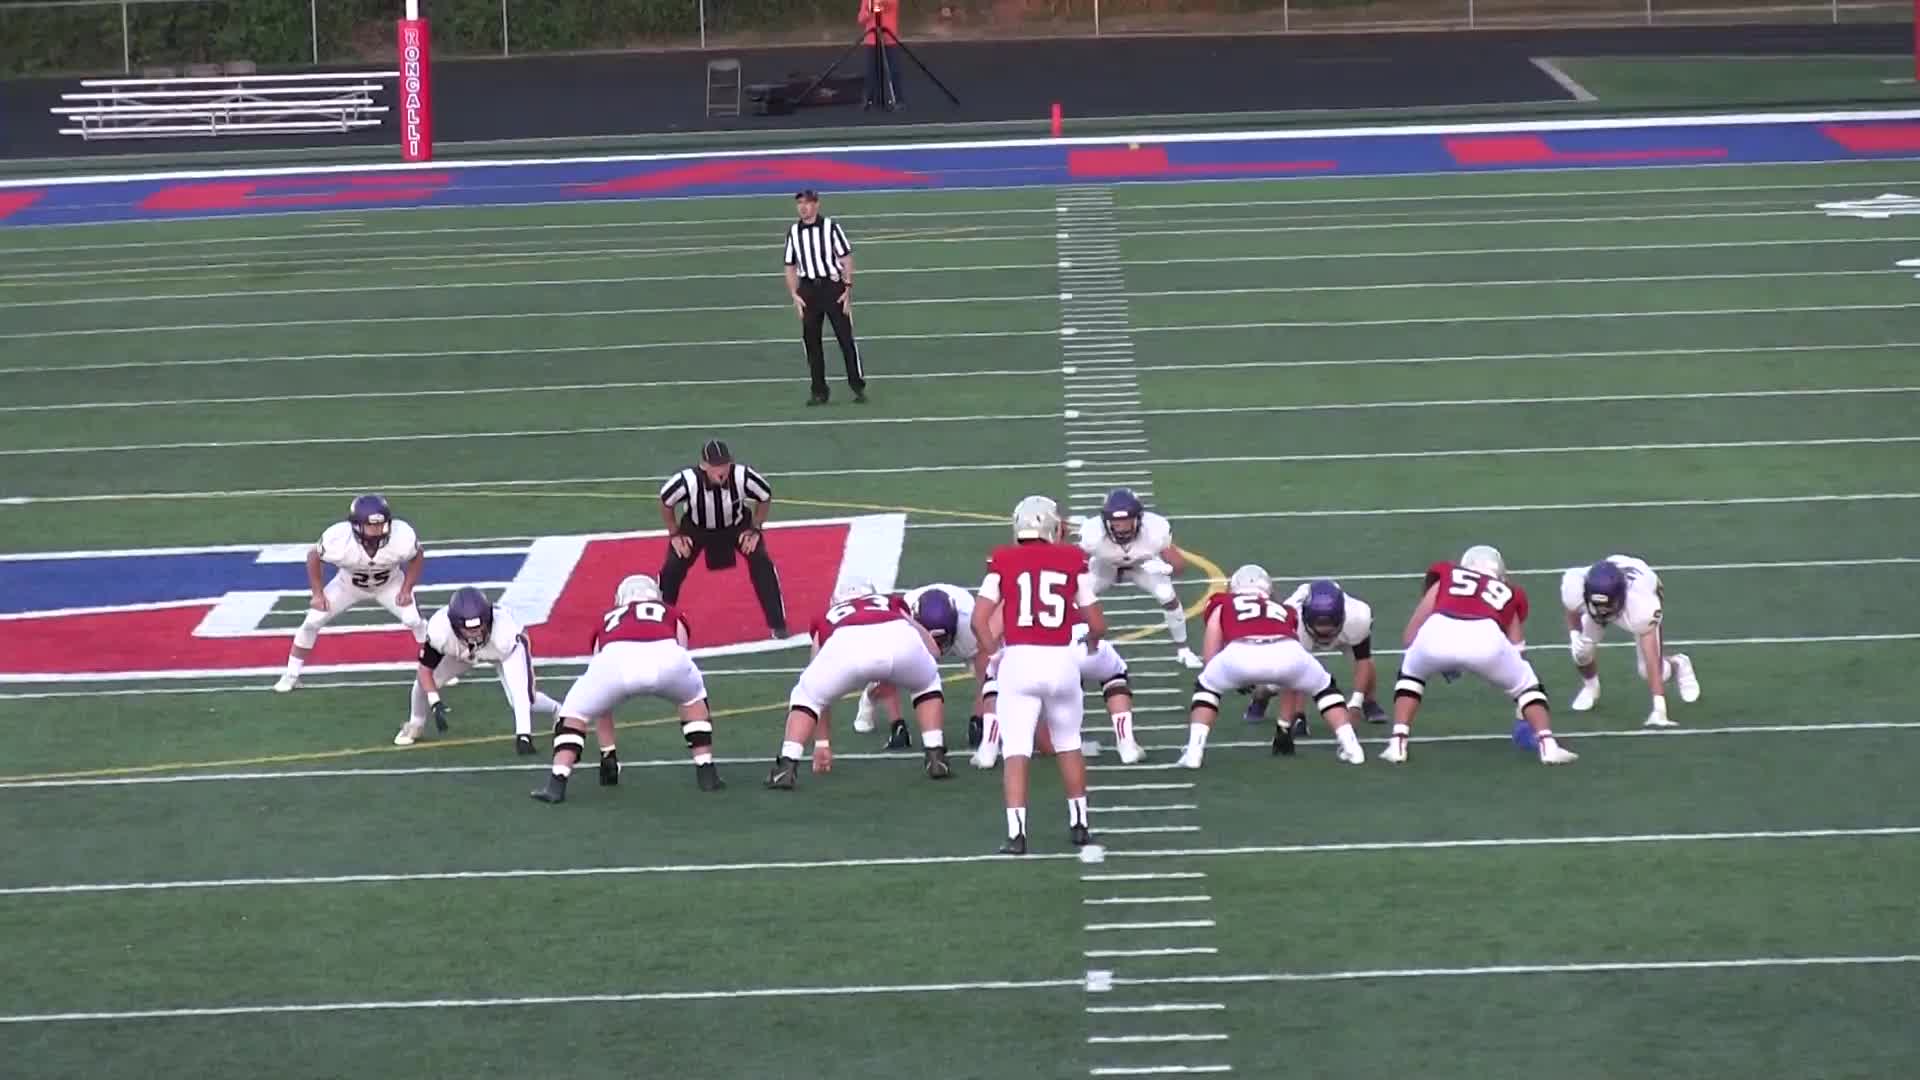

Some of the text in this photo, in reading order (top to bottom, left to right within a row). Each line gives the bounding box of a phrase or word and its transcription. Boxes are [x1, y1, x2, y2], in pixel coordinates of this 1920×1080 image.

[404, 28, 420, 156] RONCALLI
[352, 570, 390, 588] 25
[1448, 567, 1513, 610] 59
[603, 601, 666, 632] 70
[825, 595, 890, 624] 63
[1016, 569, 1068, 628] 15
